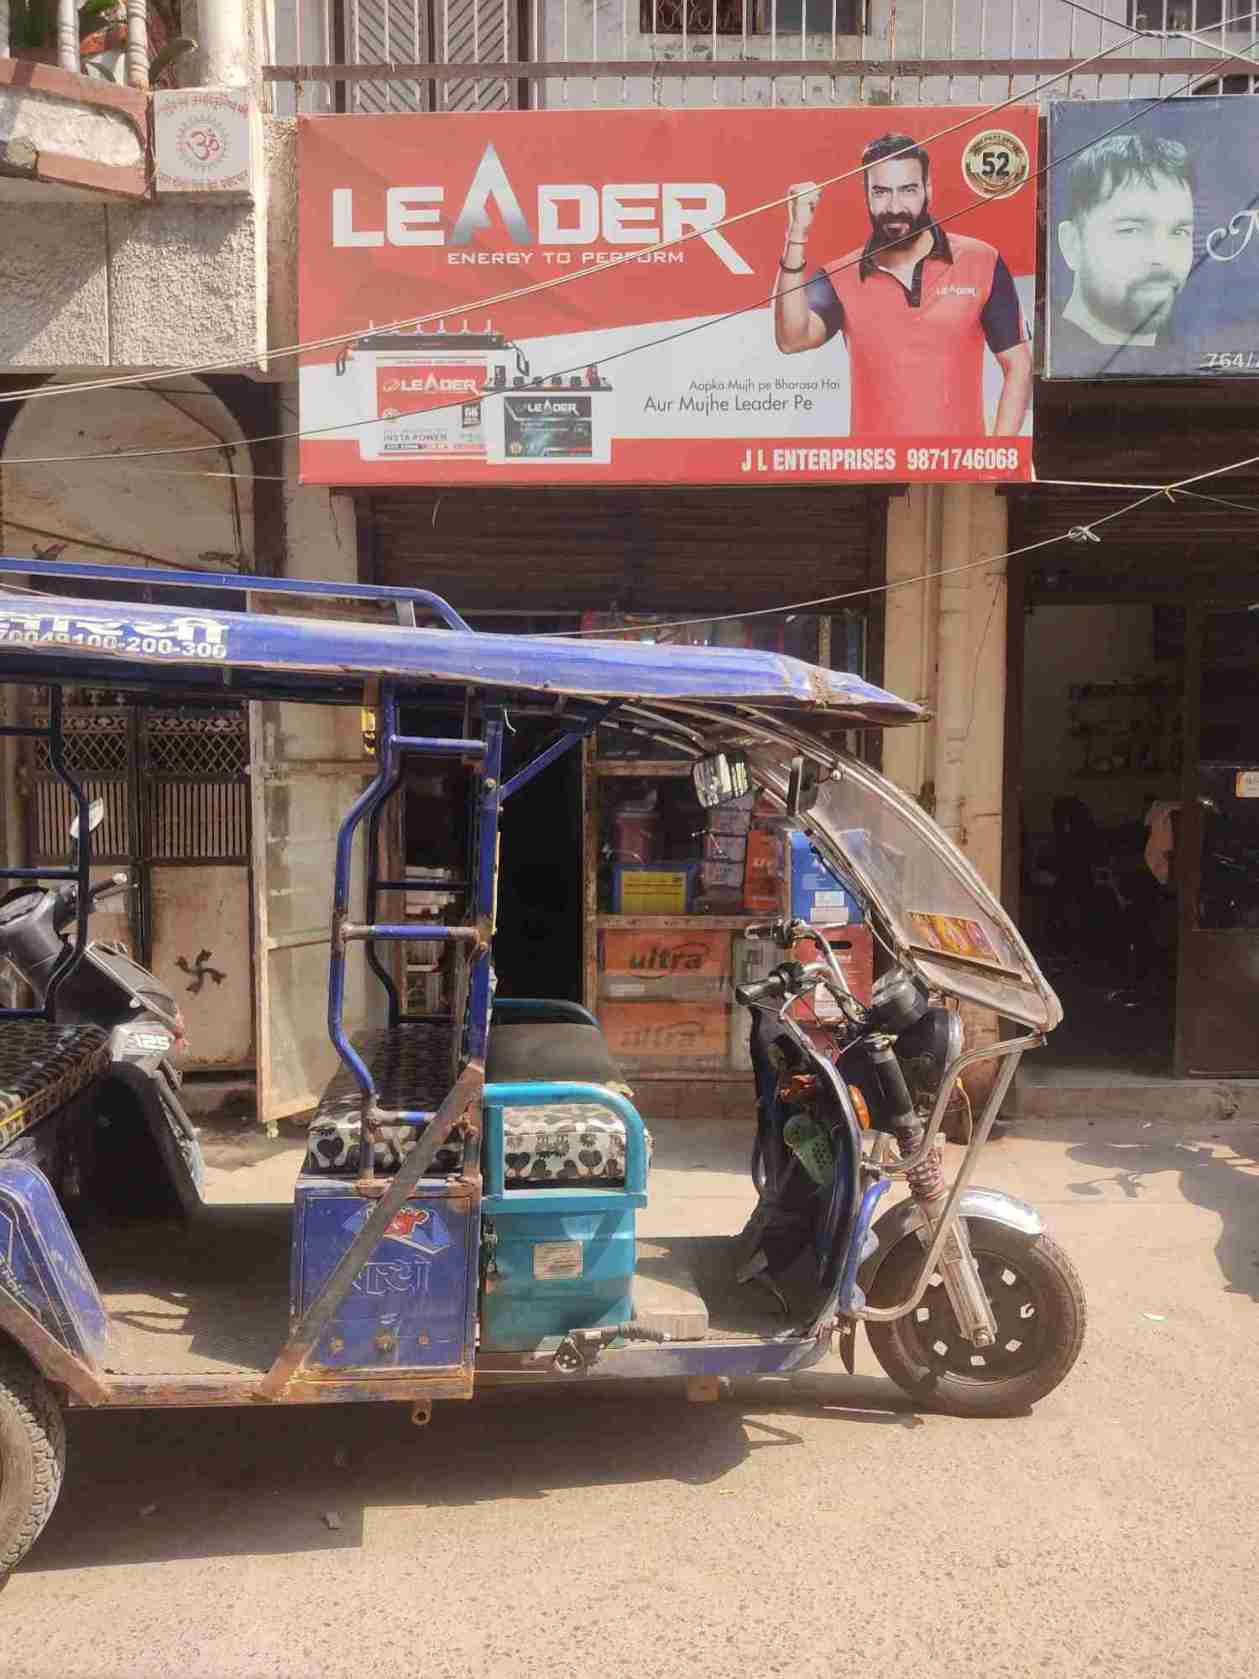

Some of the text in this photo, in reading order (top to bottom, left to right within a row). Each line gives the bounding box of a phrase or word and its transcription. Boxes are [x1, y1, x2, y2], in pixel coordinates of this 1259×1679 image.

[982, 151, 1010, 176] 52
[332, 141, 755, 274] LEADER
[447, 251, 685, 265] ENERGY TO PERFORM
[400, 373, 481, 396] LEADER
[689, 378, 725, 392] Aapka
[775, 376, 818, 390] Bharasa
[822, 377, 841, 389] Hai
[527, 399, 580, 416] LEADER
[644, 392, 814, 416] Aur Mujhe Leader Pe
[740, 447, 1019, 471] J L ENTERPRISES 9871746068
